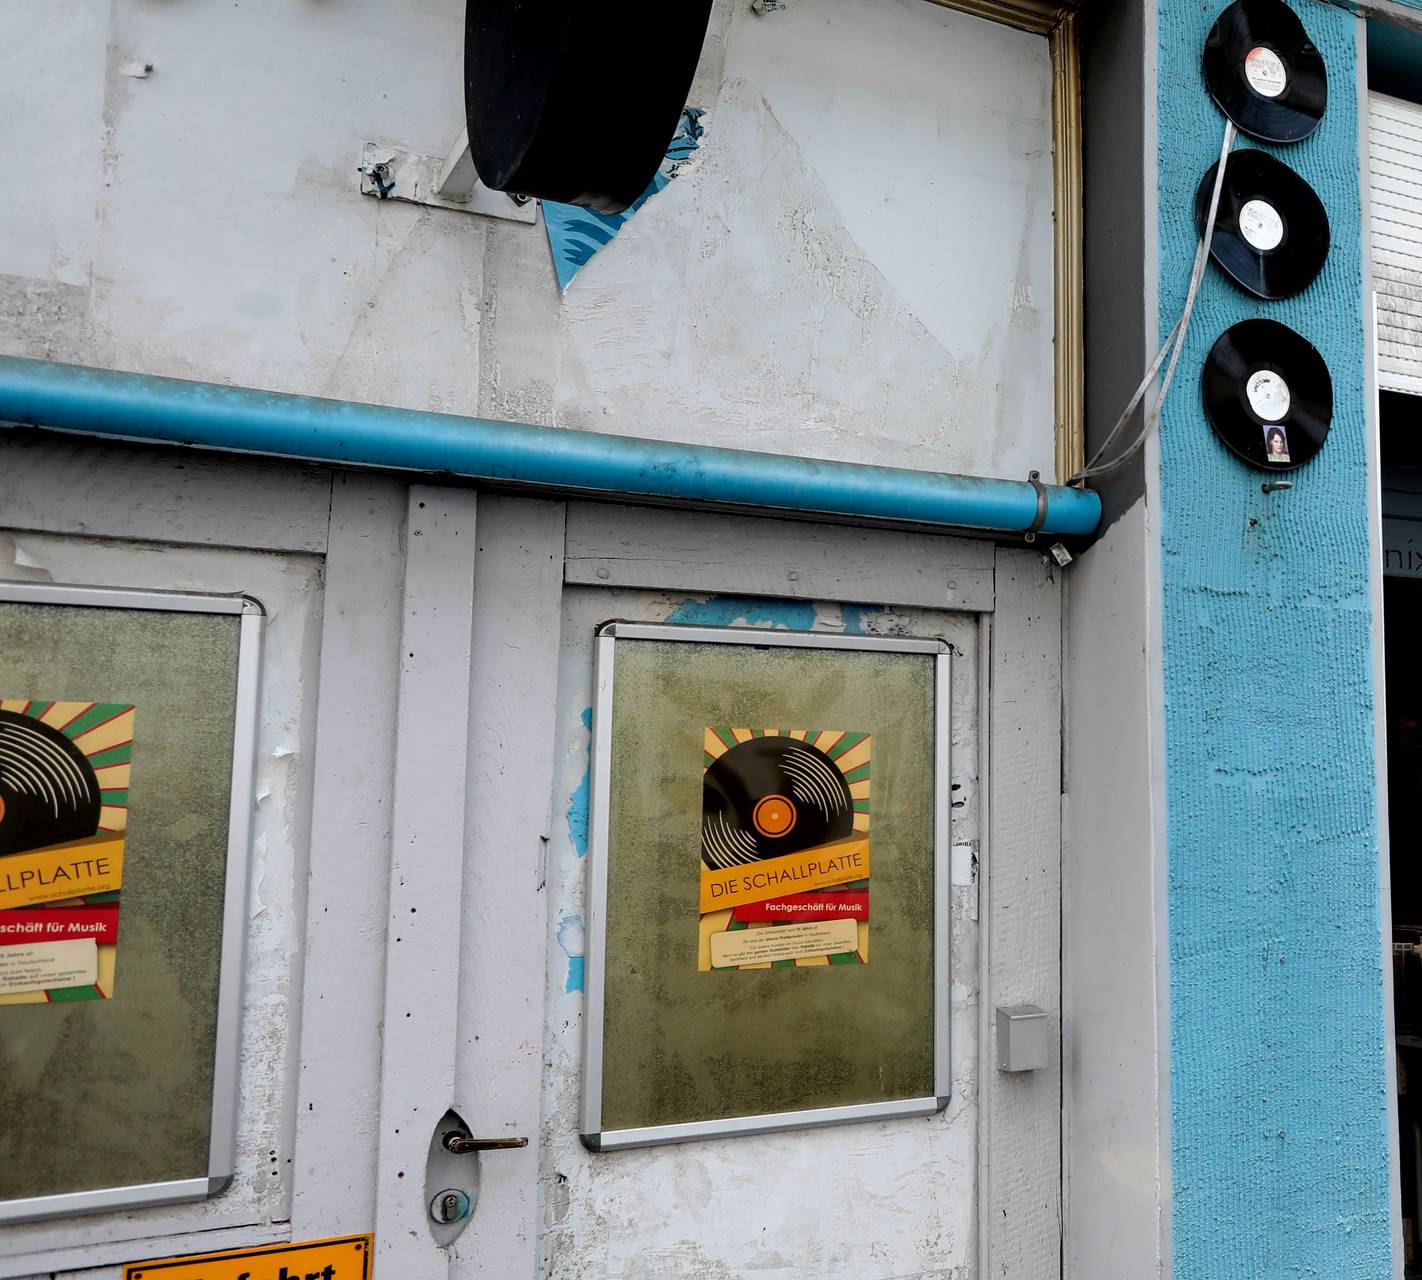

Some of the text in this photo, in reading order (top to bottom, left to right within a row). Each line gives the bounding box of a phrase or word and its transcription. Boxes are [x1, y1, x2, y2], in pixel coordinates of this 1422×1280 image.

[711, 879, 739, 898] DIE
[743, 853, 862, 891] SCHALLPLATTE
[765, 903, 863, 912] Fachgeschäft für Musik
[46, 922, 65, 933] für
[68, 922, 107, 933] Musik
